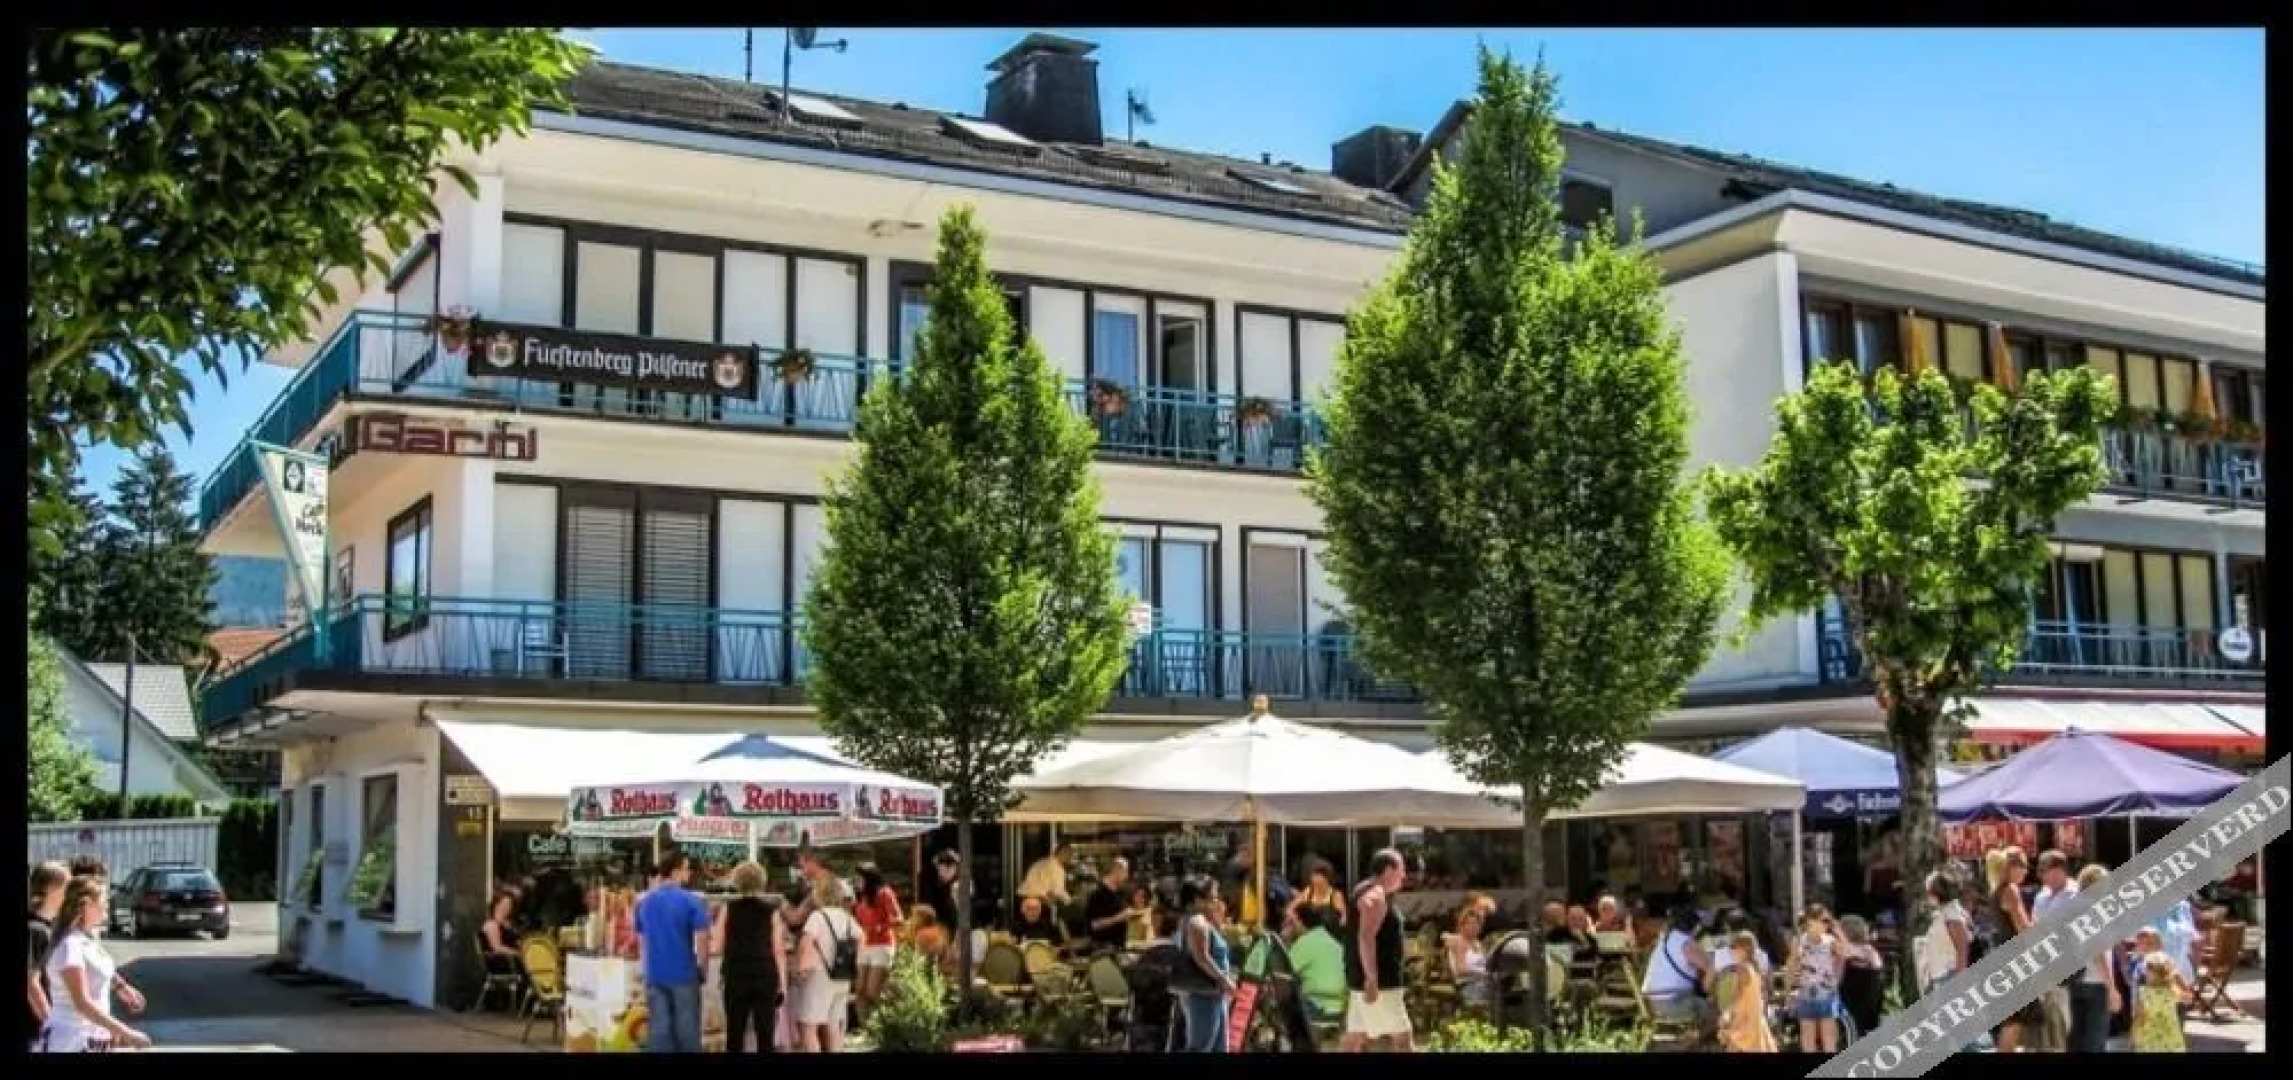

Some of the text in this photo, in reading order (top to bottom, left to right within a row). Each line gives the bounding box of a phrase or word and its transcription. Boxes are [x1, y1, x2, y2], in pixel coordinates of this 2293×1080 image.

[610, 788, 678, 816] Rothaus
[742, 783, 838, 814] Rothaus
[878, 788, 939, 818] Rothaus
